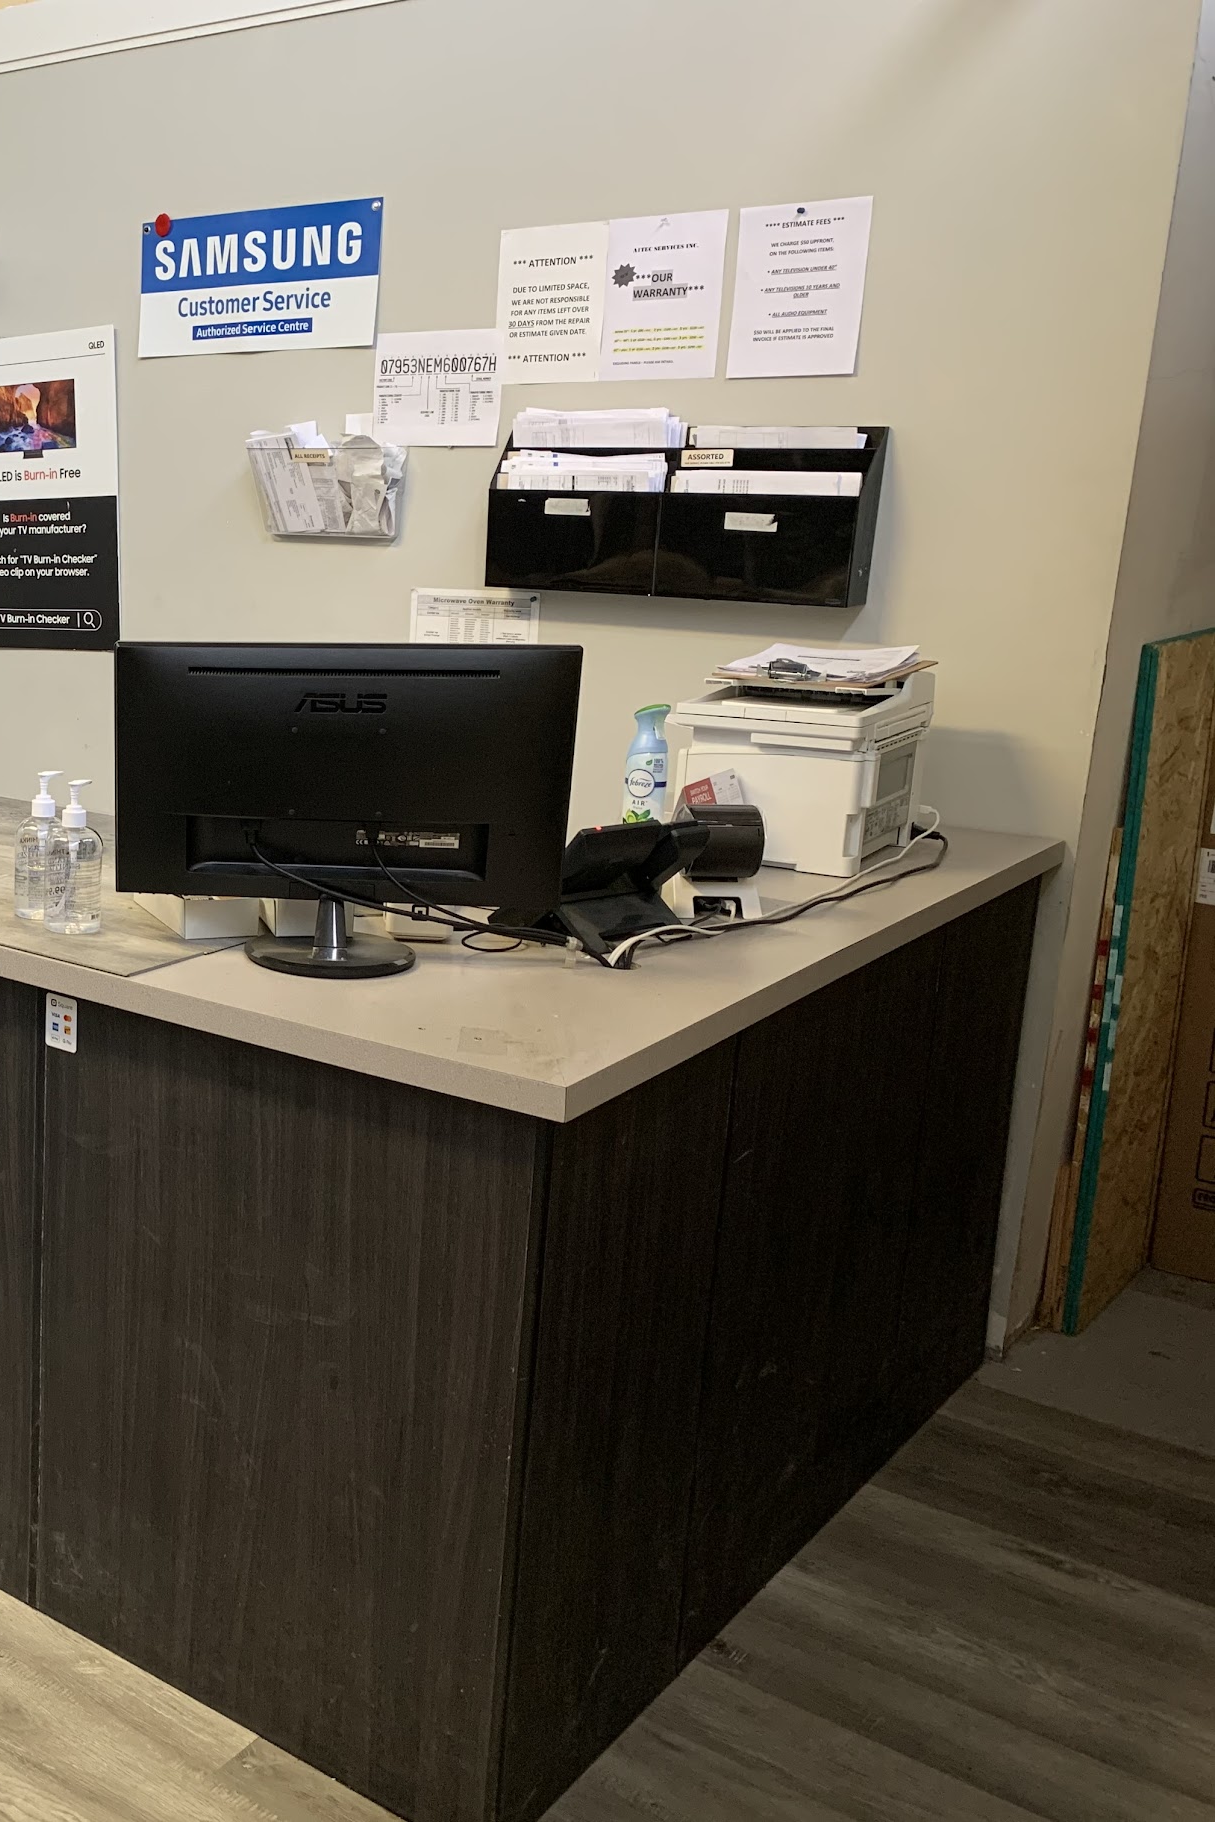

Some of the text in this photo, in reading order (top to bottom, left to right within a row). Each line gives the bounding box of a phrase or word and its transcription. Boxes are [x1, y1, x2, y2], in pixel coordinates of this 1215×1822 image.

[782, 220, 814, 229] ESTIMATE
[155, 221, 362, 281] SAMSUNG
[529, 256, 577, 268] ATTENTION
[538, 284, 566, 292] LIMITED
[566, 282, 590, 291] SPACE,
[178, 287, 331, 318] Customer Service
[549, 295, 590, 304] RESPONSIBLE
[196, 321, 308, 338] Authorized Service Centre
[517, 320, 534, 328] DAYS
[88, 341, 105, 350] QLED
[522, 354, 570, 363] ATTENTION
[14, 470, 22, 481] is
[24, 468, 57, 480] Burn-in
[60, 468, 81, 479] Free
[2, 511, 71, 523] Is Burn-in covered
[0, 526, 16, 538] your
[18, 526, 27, 534] TV
[28, 523, 87, 534] manufacturer?
[7, 554, 18, 564] for
[34, 554, 61, 564] Burn-in
[10, 567, 24, 579] clip
[36, 568, 53, 579] your
[54, 567, 90, 576] browser.
[486, 599, 514, 607] Warranty
[7, 613, 35, 623] Burn-in
[36, 614, 70, 624] Checker
[294, 692, 388, 714] ASUS
[629, 777, 652, 788] febreze
[691, 791, 712, 804] PAYROLL
